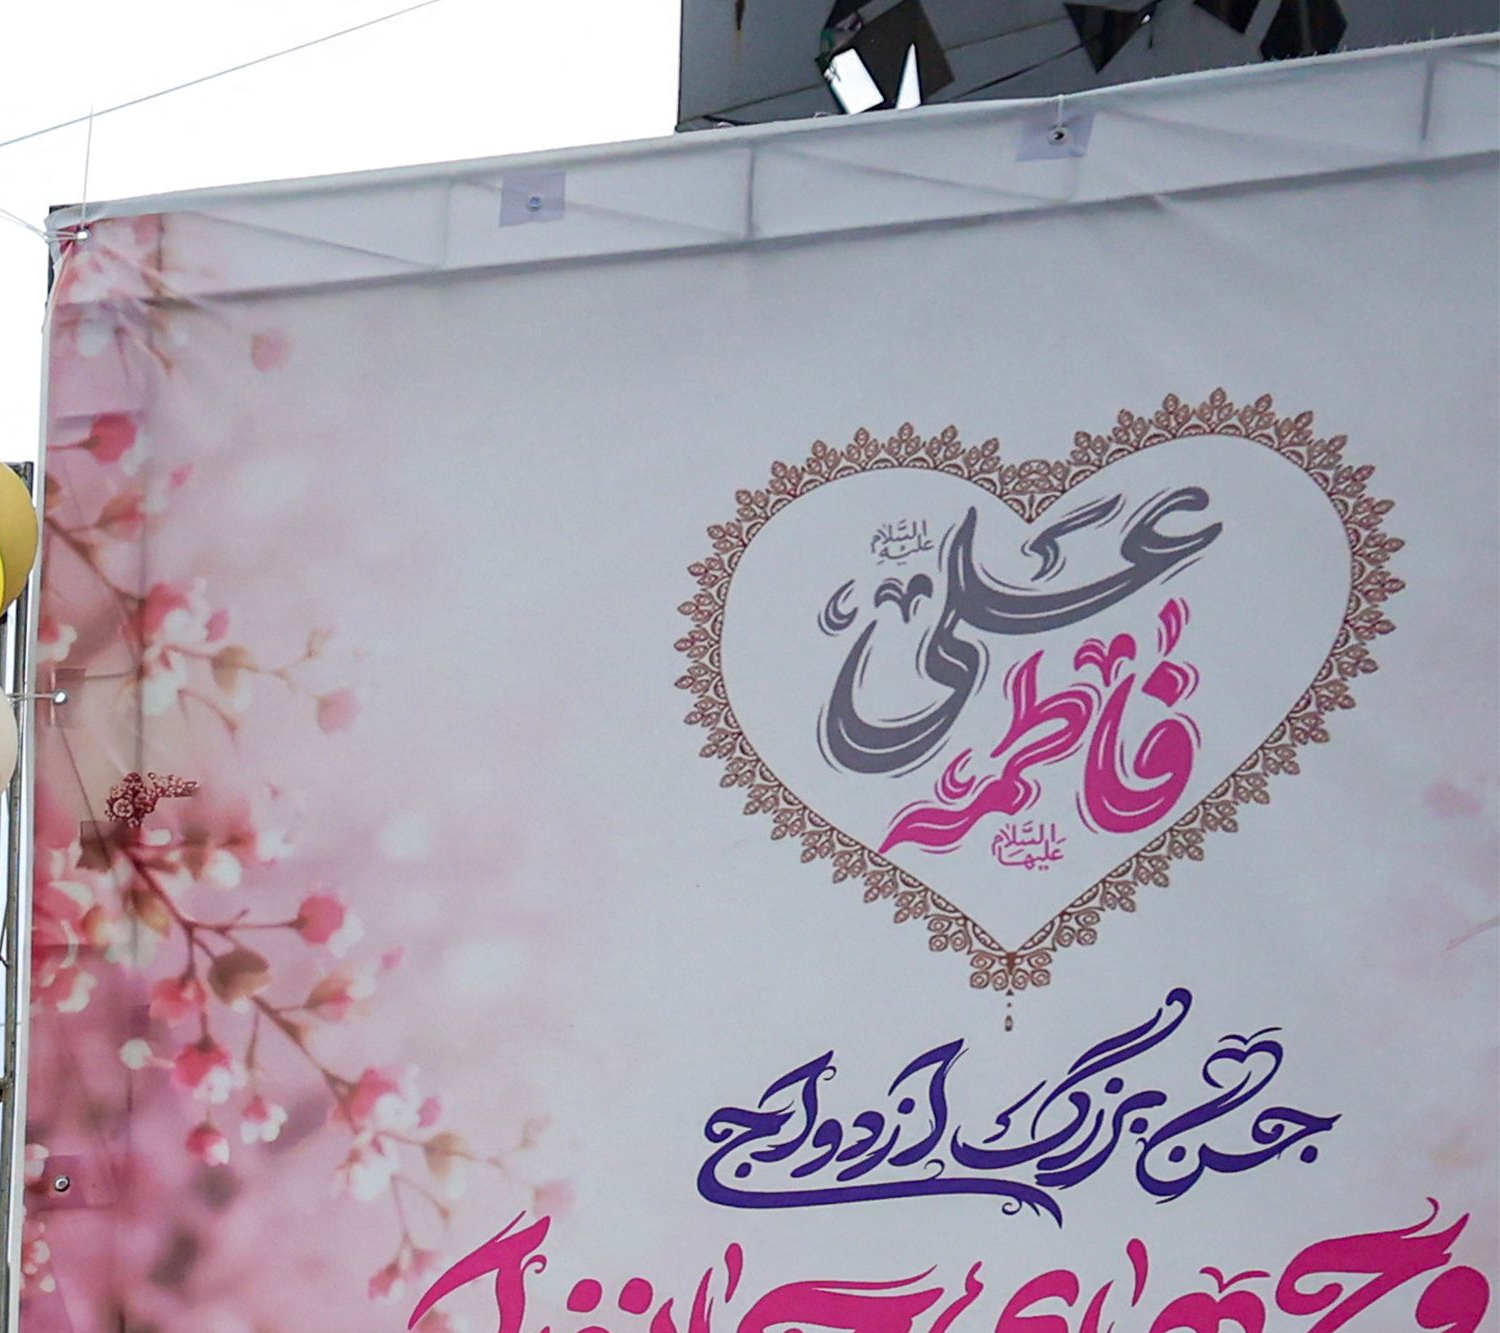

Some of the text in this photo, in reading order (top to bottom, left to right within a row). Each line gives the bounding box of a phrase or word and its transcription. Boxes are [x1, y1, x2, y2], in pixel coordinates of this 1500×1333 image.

[817, 485, 1223, 777] علی
[878, 597, 1202, 856] فاطمه
[697, 987, 1342, 1229] جشن بزرگ ازدواج
